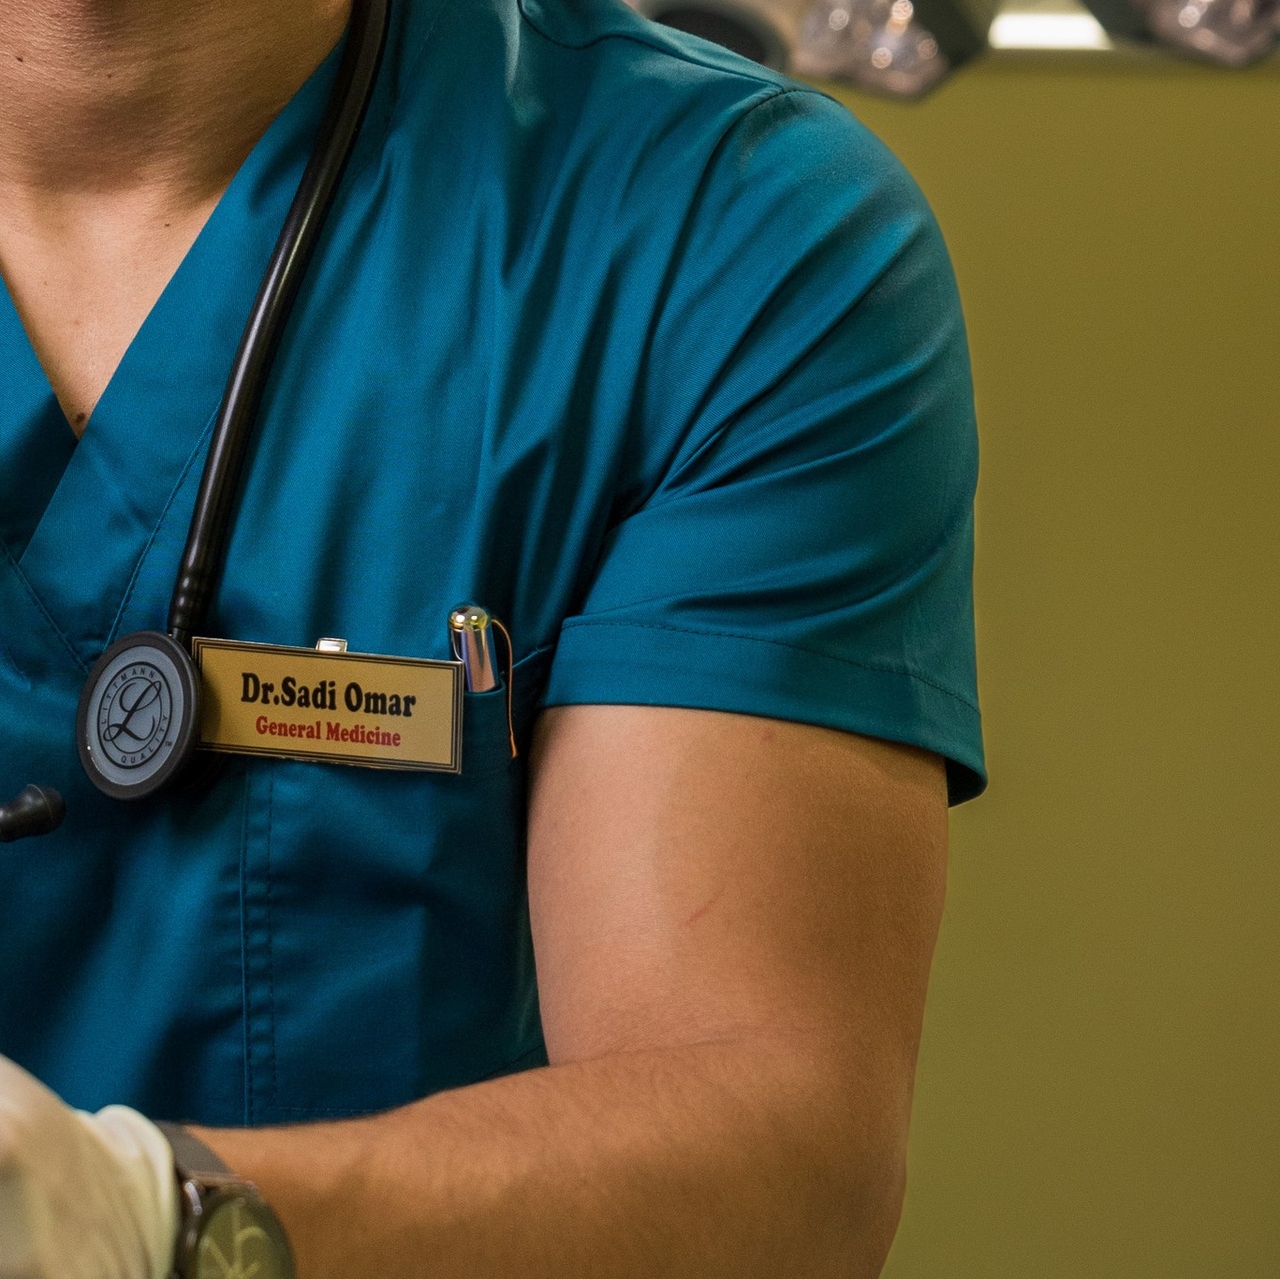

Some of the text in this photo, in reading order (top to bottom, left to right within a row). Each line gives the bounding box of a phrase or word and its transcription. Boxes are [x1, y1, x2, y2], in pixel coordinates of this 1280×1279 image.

[101, 667, 155, 725] LITTMANN
[241, 672, 416, 717] Dr.Sadi Omar
[121, 714, 168, 764] QUALITY
[255, 715, 401, 747] General Medicine
